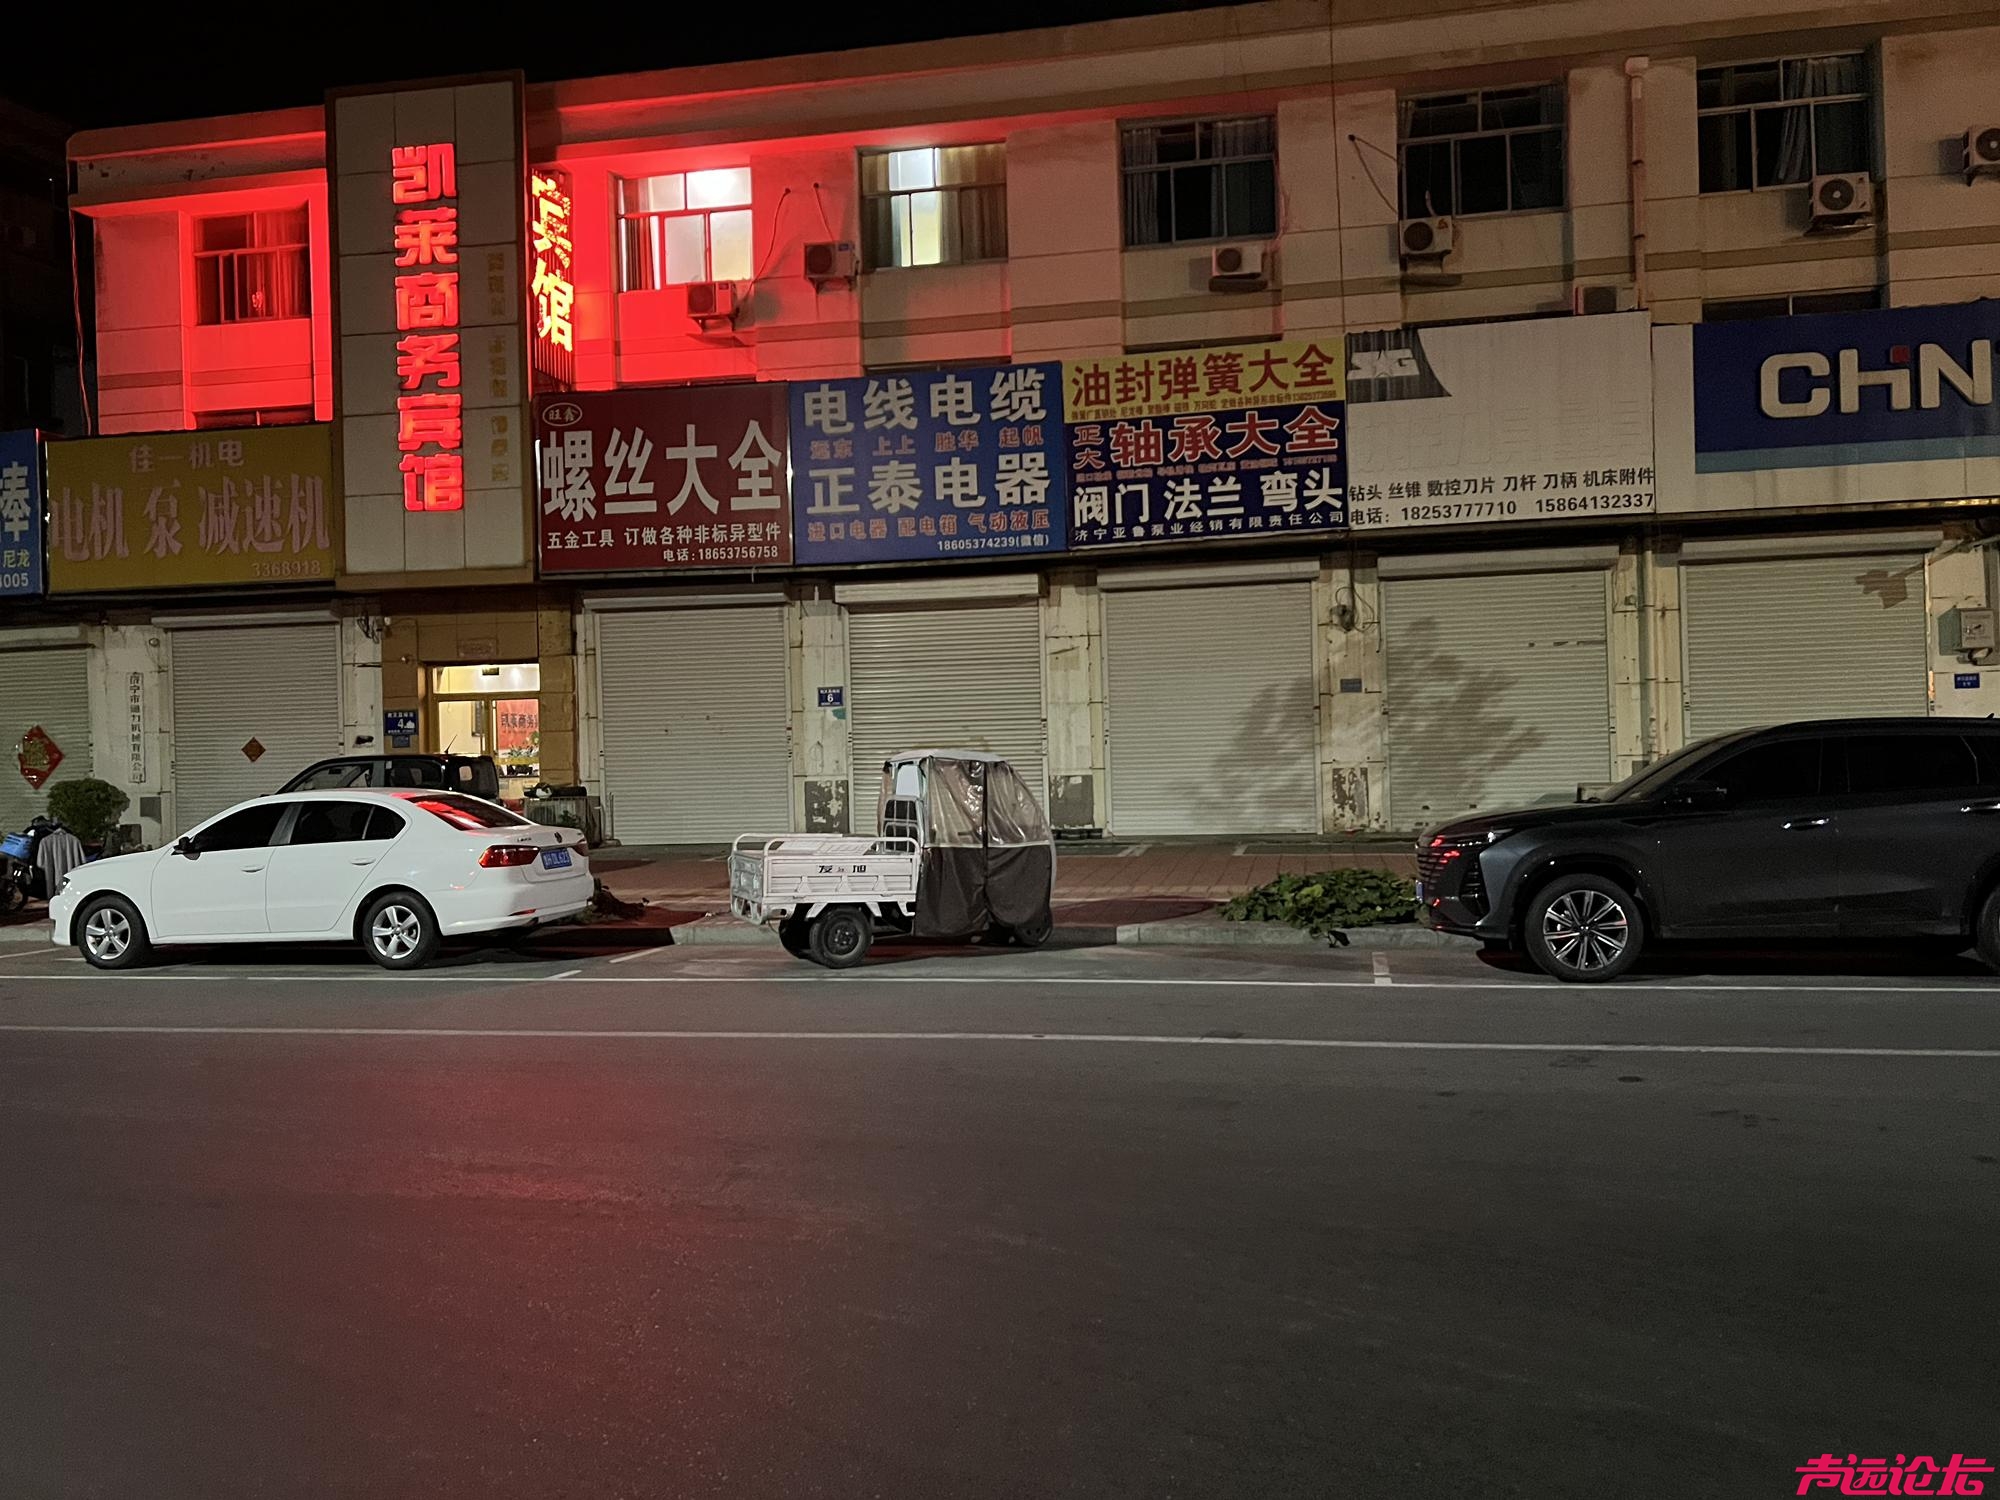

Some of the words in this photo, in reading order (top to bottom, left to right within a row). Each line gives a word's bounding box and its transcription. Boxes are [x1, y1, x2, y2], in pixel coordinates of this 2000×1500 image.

[392, 142, 463, 512] 凯莱商务宾馆
[1072, 344, 1335, 407] 油封弹簧大全
[548, 408, 577, 422] 旺鑫
[804, 368, 1047, 434] 电线电缆
[873, 435, 916, 456] 上上
[935, 430, 979, 452] 胜华
[999, 425, 1044, 448] 起帆
[1073, 424, 1105, 469] 正大
[1109, 405, 1340, 467] 轴承大全
[129, 439, 244, 473] 佳一机电
[543, 419, 782, 522] 螺丝大全
[807, 452, 1051, 514] 正泰电器
[1074, 483, 1149, 527] 阀门
[1164, 476, 1244, 520] 法兰
[1260, 467, 1343, 512] 弯头
[1349, 483, 1382, 502] 钻头
[1388, 480, 1422, 500] 丝锥
[1427, 477, 1496, 497] 数控刀片
[1503, 474, 1537, 493] 刀杆
[1543, 471, 1577, 490] 刀柄
[1583, 467, 1654, 488] 机床附件
[51, 481, 129, 562] 电机
[142, 478, 183, 558] 泵
[199, 473, 330, 555] 减速机
[1401, 500, 1517, 521] 18253777710
[1536, 494, 1654, 513] 15864132337
[547, 529, 614, 549] 五金工具
[624, 522, 781, 546] 订做各种非标异型件
[808, 518, 887, 542] 进口电器
[898, 514, 957, 538] 配电箱
[968, 509, 1050, 533] 气动液压
[1075, 511, 1343, 541] 济宁亚鲁泵业经销有限责任公司
[0, 573, 29, 588] 005
[253, 560, 321, 578] 3368918
[827, 693, 834, 703] 6
[397, 718, 404, 729] 4
